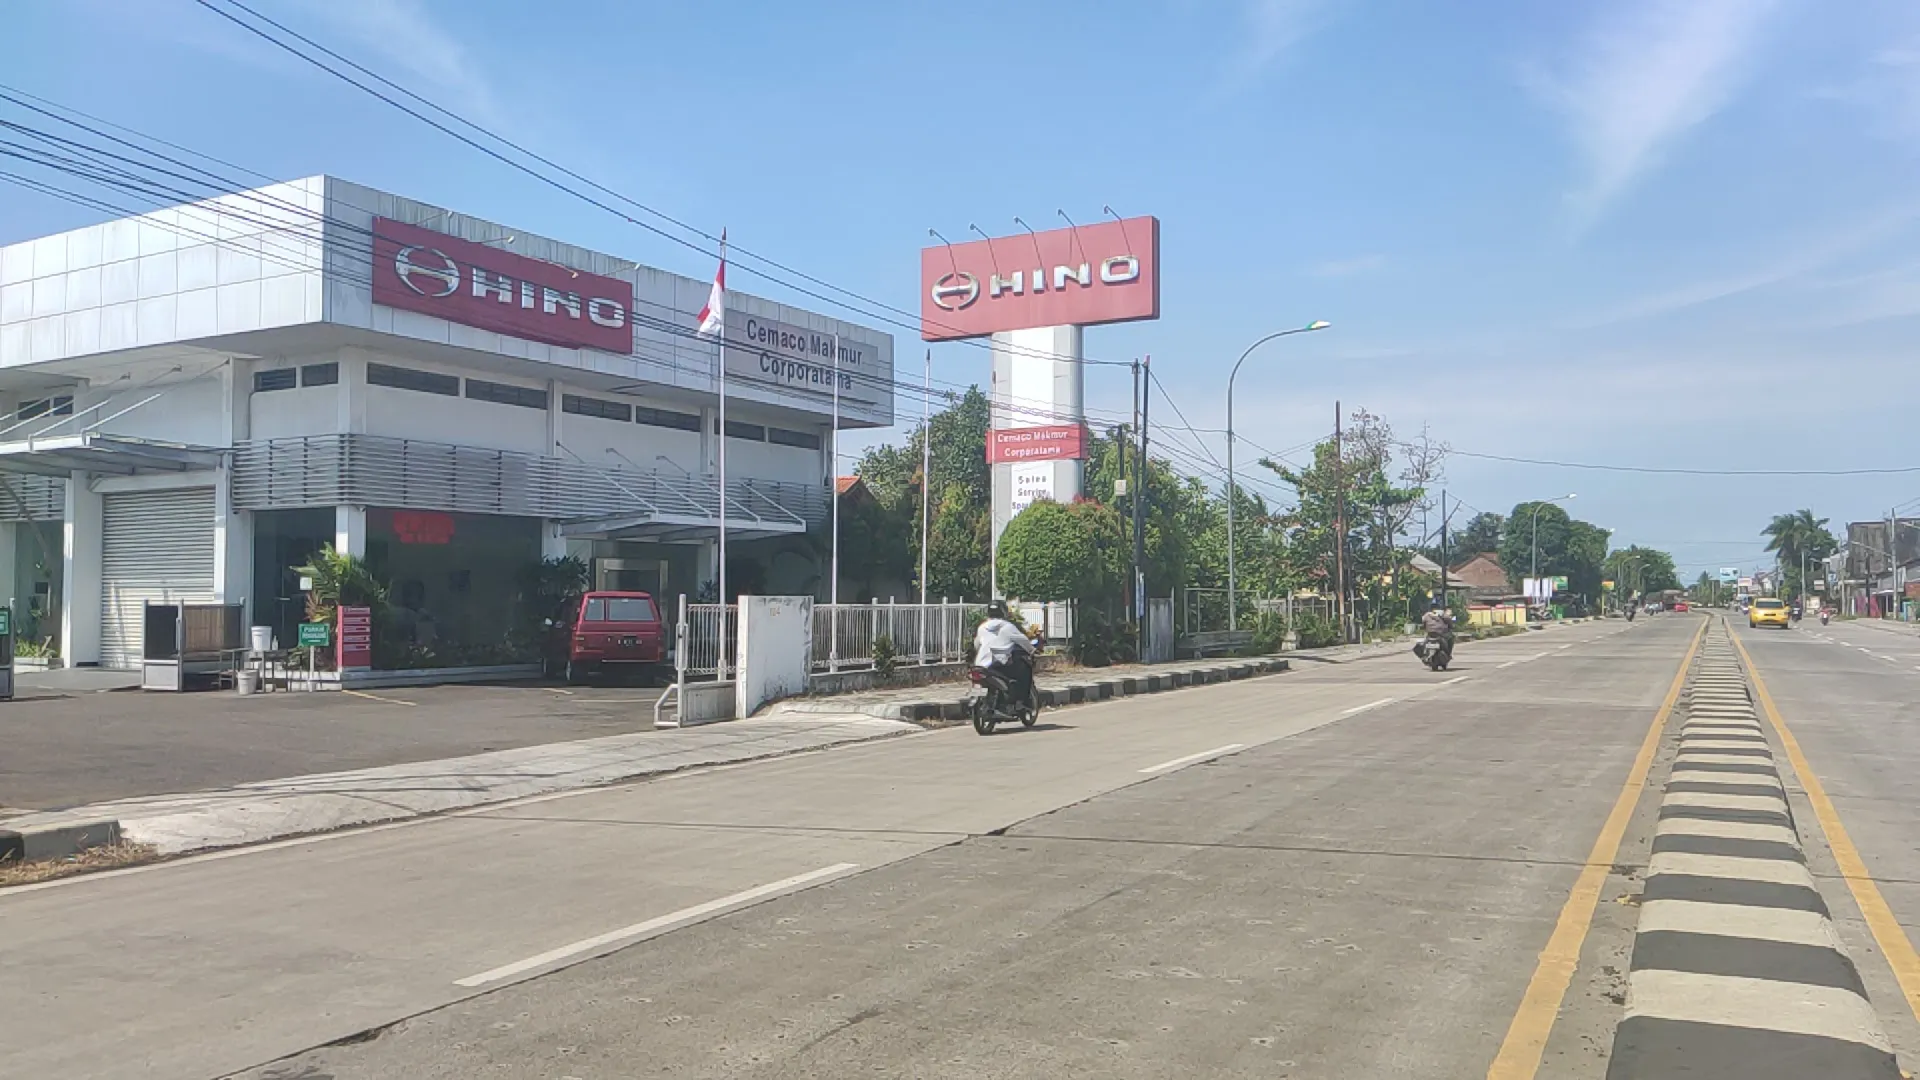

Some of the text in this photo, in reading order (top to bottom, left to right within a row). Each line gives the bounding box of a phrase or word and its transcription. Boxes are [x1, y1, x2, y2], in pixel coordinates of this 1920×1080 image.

[989, 255, 1140, 299] HINO
[472, 266, 626, 329] HINO
[746, 319, 863, 366] Cemaco Makmur
[997, 430, 1068, 443] Cemaco Makmur
[1004, 446, 1062, 459] Corporatama
[1017, 475, 1047, 485] Sales
